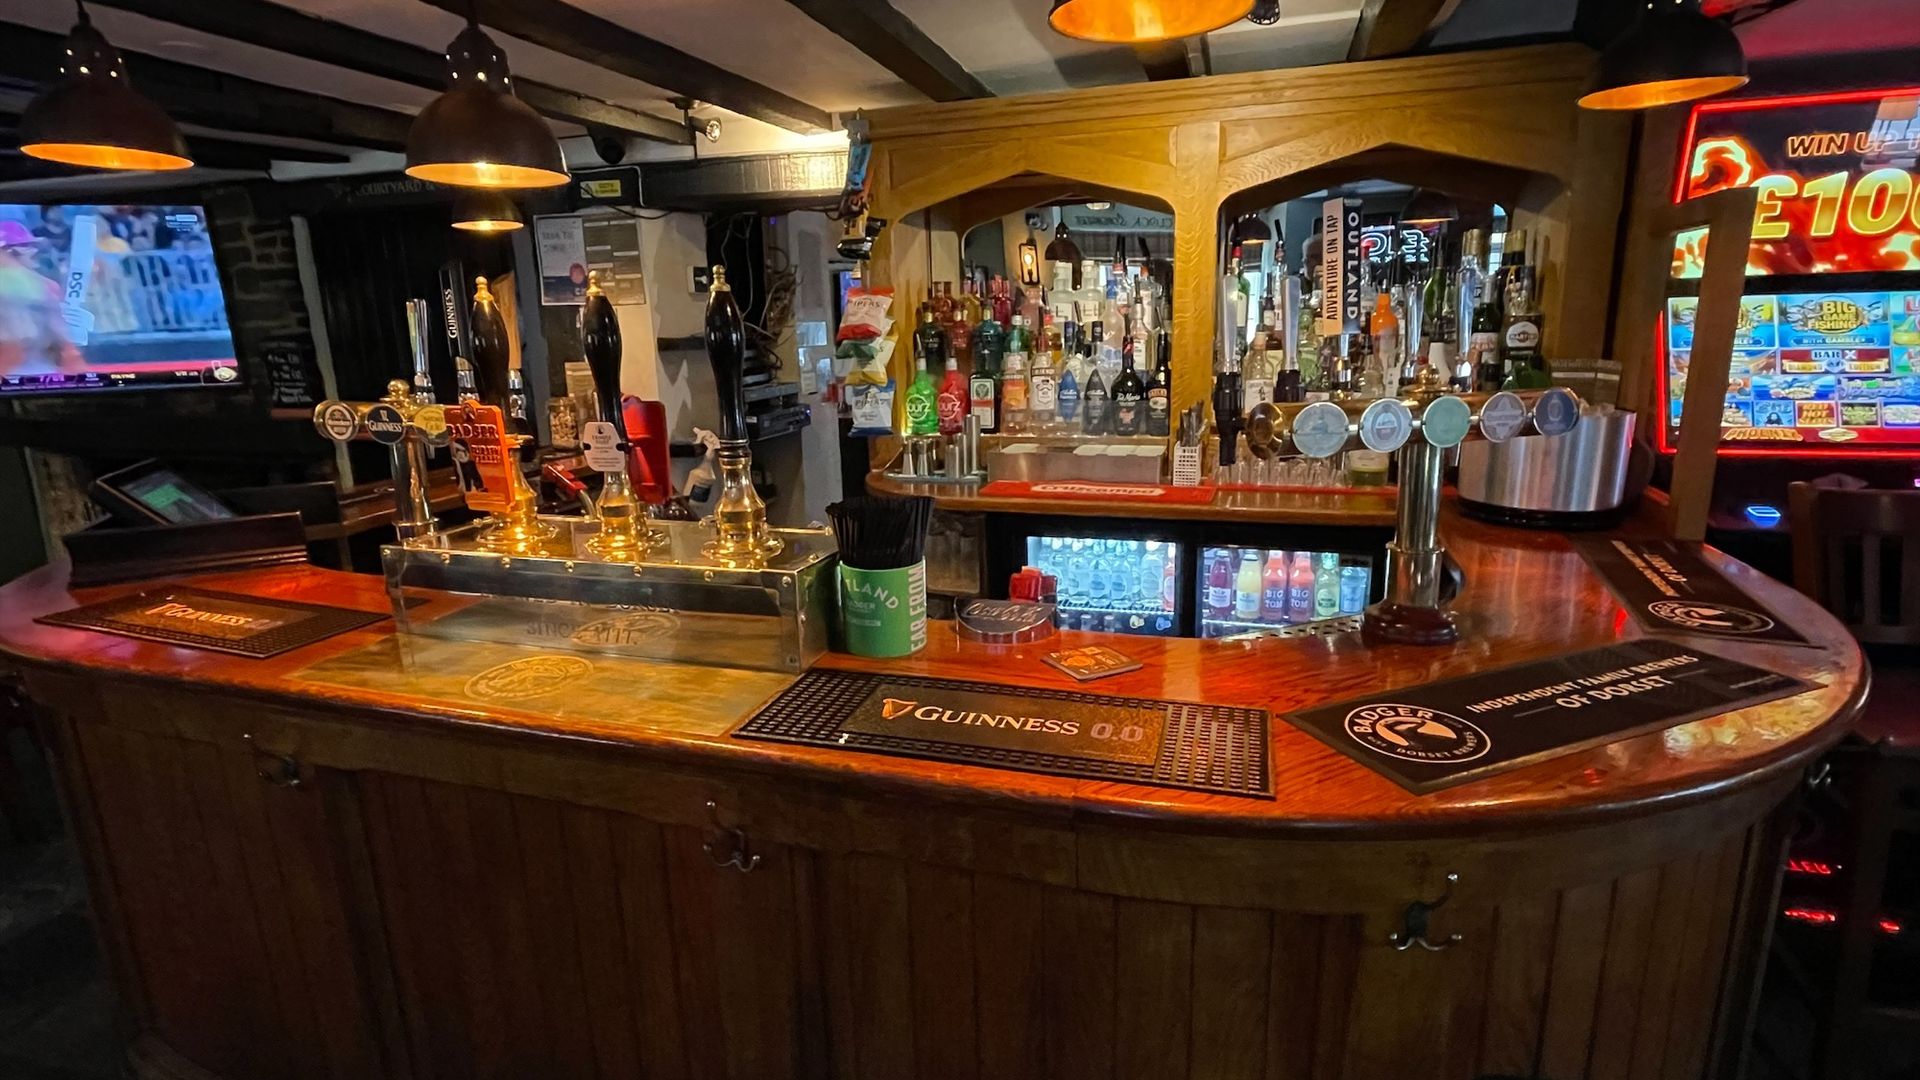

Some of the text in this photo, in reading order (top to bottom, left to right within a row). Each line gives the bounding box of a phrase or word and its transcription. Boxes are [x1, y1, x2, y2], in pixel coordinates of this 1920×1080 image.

[1788, 132, 1850, 157] WIN
[1854, 129, 1898, 153] UP
[1750, 168, 1920, 239] £10
[1326, 214, 1339, 321] ADVENTURE ON TAP
[1347, 211, 1359, 319] OUTLAND
[445, 288, 458, 338] GUINNESS
[1823, 300, 1856, 314] BIG
[1823, 313, 1856, 321] GAME
[1808, 320, 1857, 330] FISHING
[1813, 349, 1858, 360] BAR X
[368, 420, 402, 432] GUINNESS
[908, 565, 927, 616] FROM
[1266, 588, 1284, 598] BIG
[1291, 588, 1309, 598] BIG
[1264, 599, 1284, 608] TOM
[1290, 599, 1309, 608] TOM
[1466, 654, 1700, 714] INDEPENDENT FAMILY BREWERS
[1555, 675, 1674, 710] OF DORSET
[914, 705, 1144, 743] GUINNESS 0.0
[1352, 706, 1434, 733] BADGER
[1396, 746, 1452, 758] DORSET
